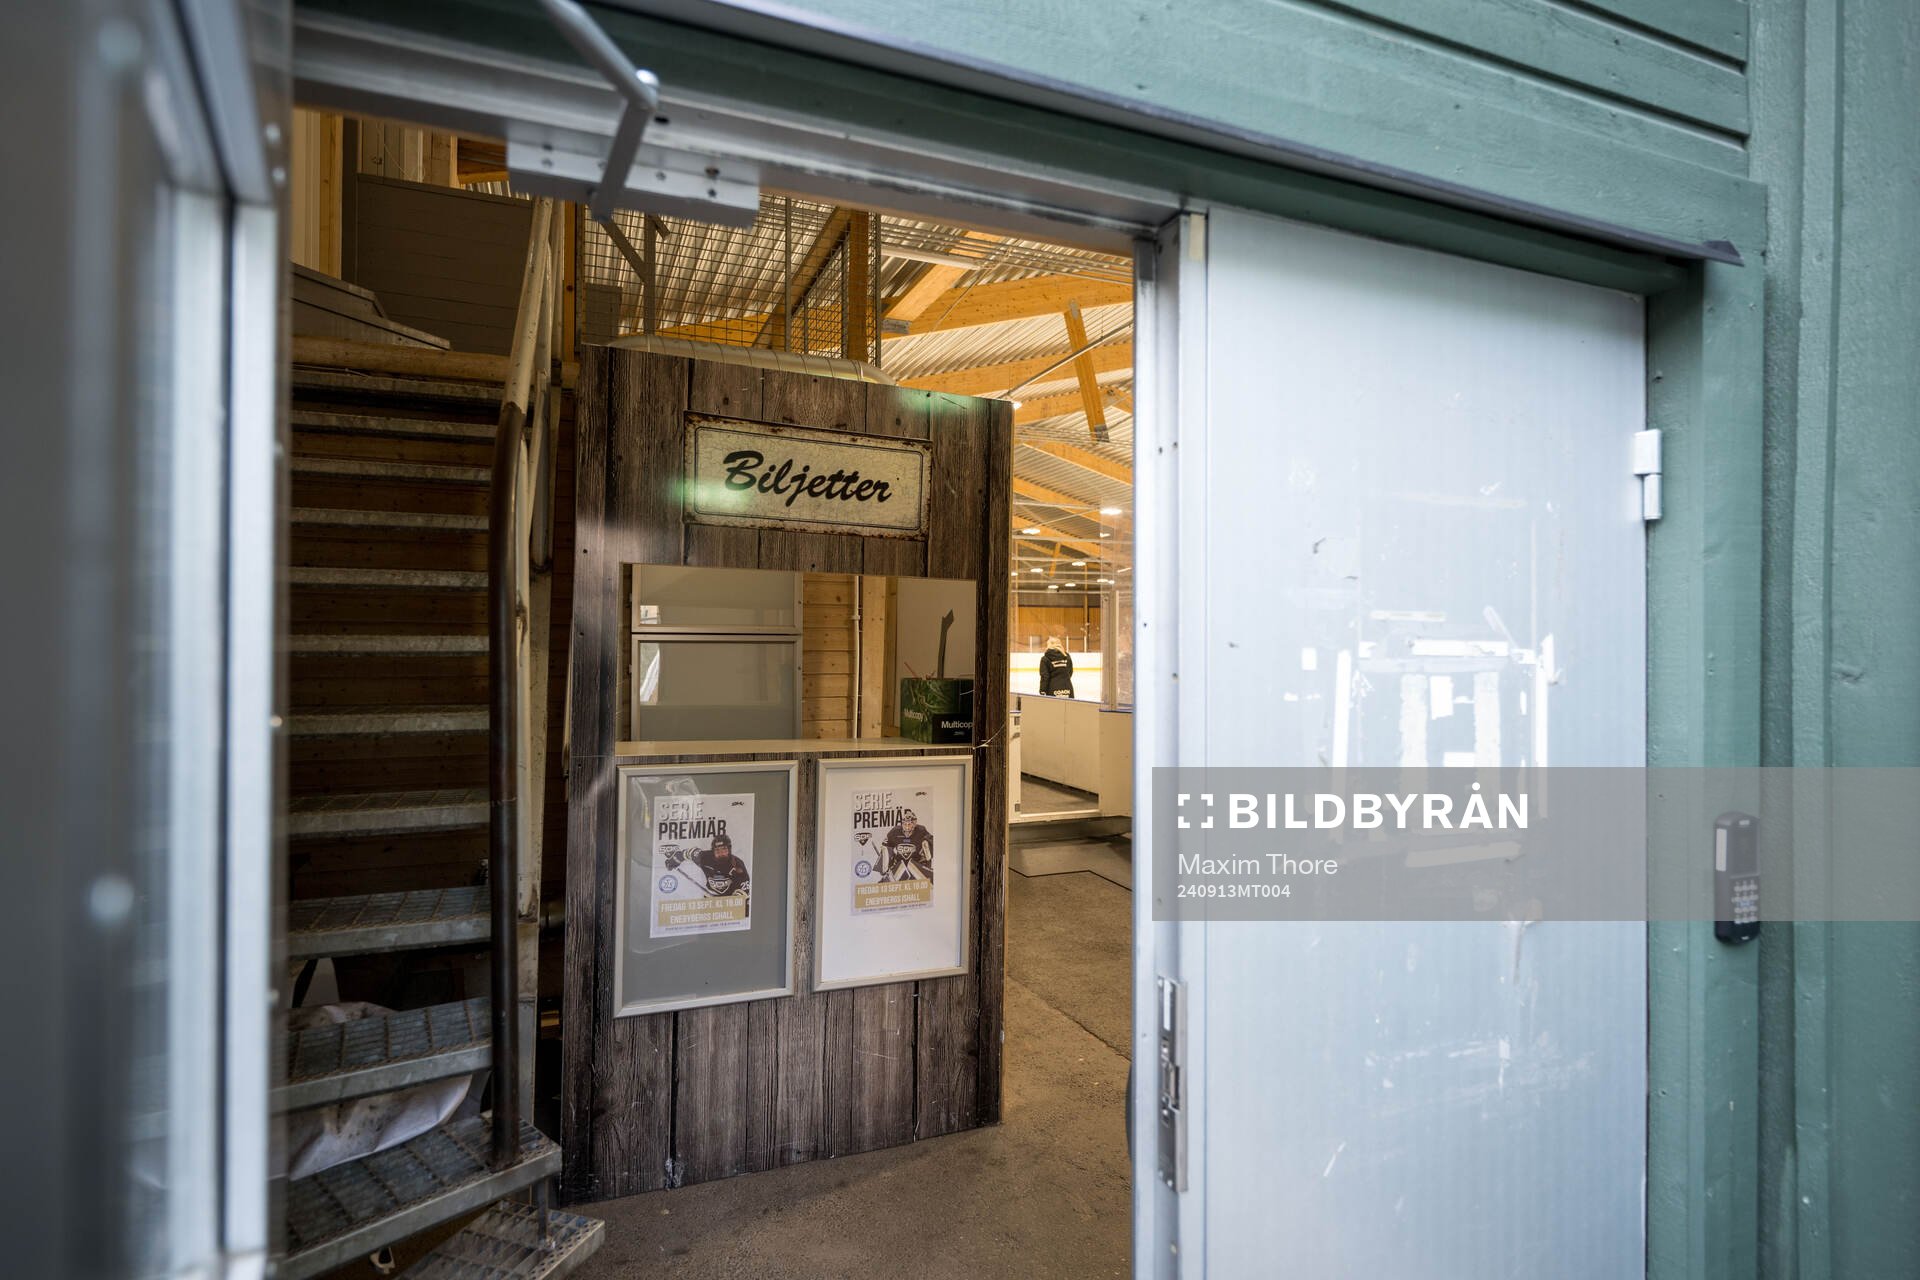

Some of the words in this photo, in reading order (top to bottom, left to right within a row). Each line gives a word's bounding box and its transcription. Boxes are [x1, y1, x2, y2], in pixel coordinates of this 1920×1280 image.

[723, 450, 892, 507] Biljetter
[941, 720, 974, 731] Multicop
[660, 799, 704, 822] SERIE
[855, 791, 893, 811] SERIE
[659, 816, 727, 840] PREMIÄR
